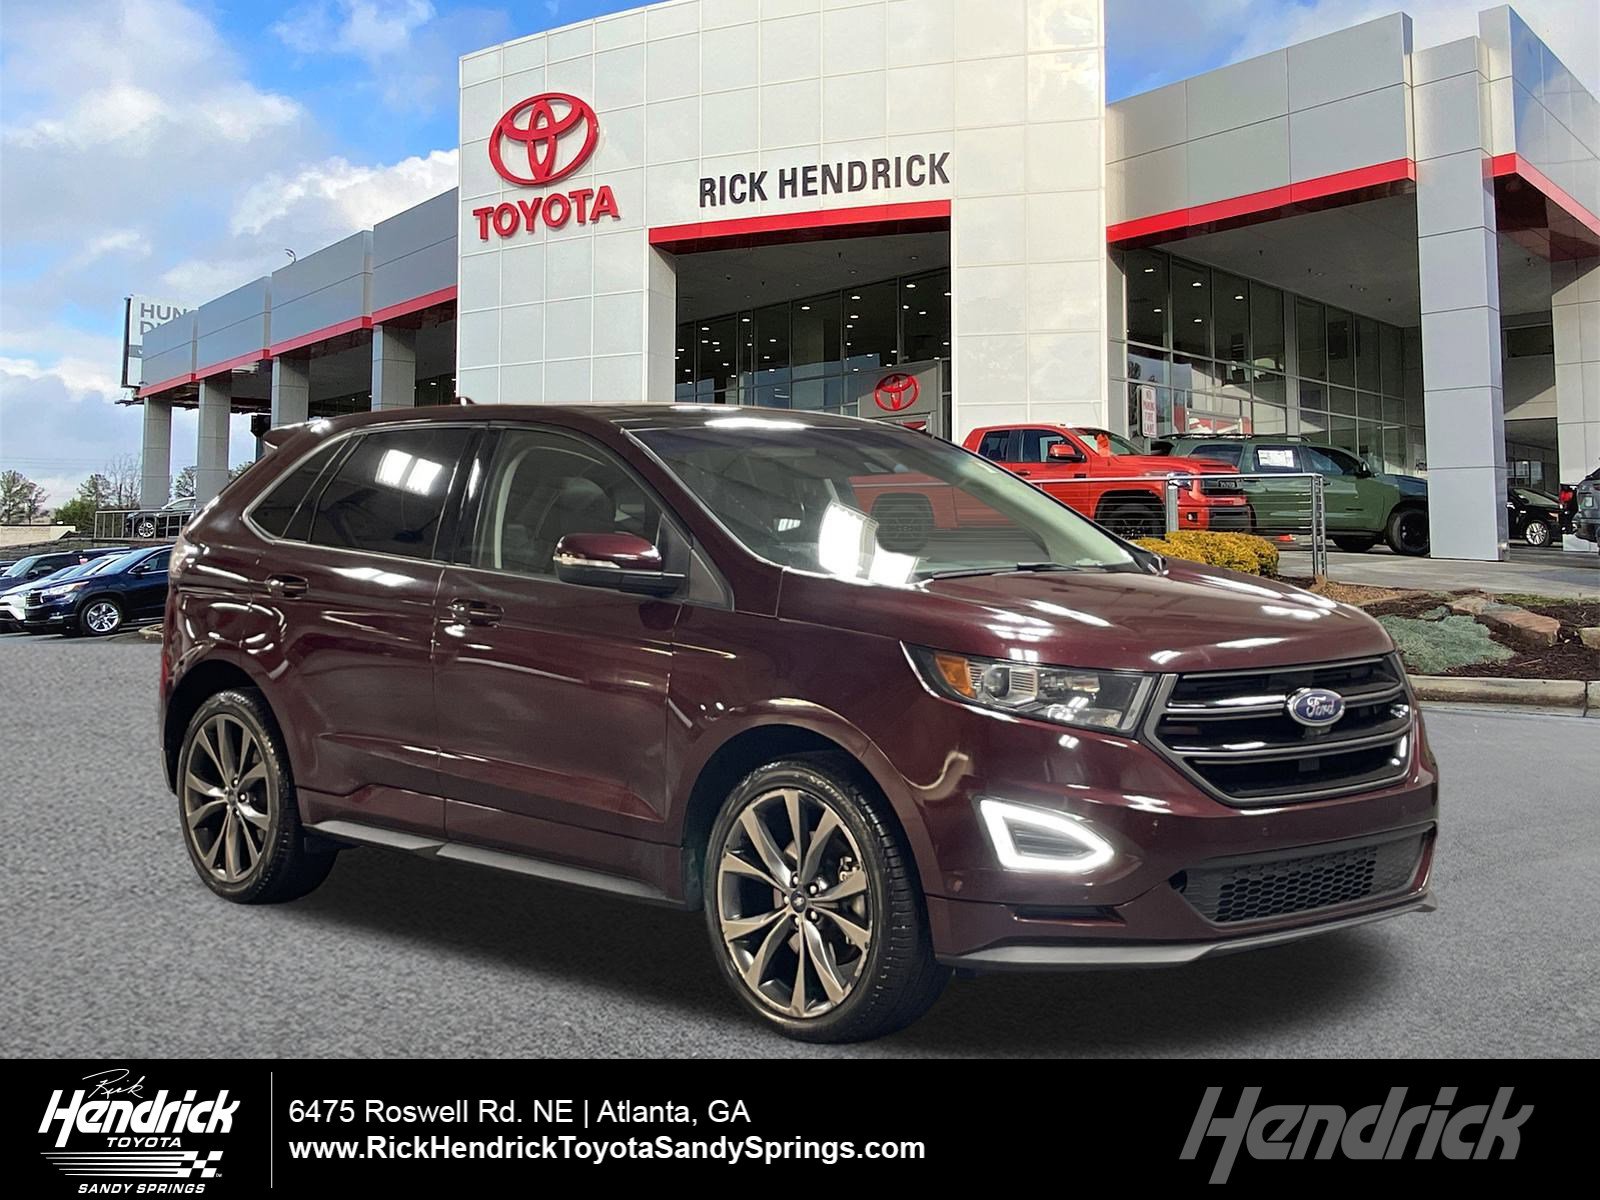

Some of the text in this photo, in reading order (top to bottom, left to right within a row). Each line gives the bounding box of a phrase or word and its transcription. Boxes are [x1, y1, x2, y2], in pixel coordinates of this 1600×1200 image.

[699, 152, 951, 208] RICK HENDRICK
[472, 185, 621, 241] TOYOTA
[1306, 696, 1335, 718] Ford
